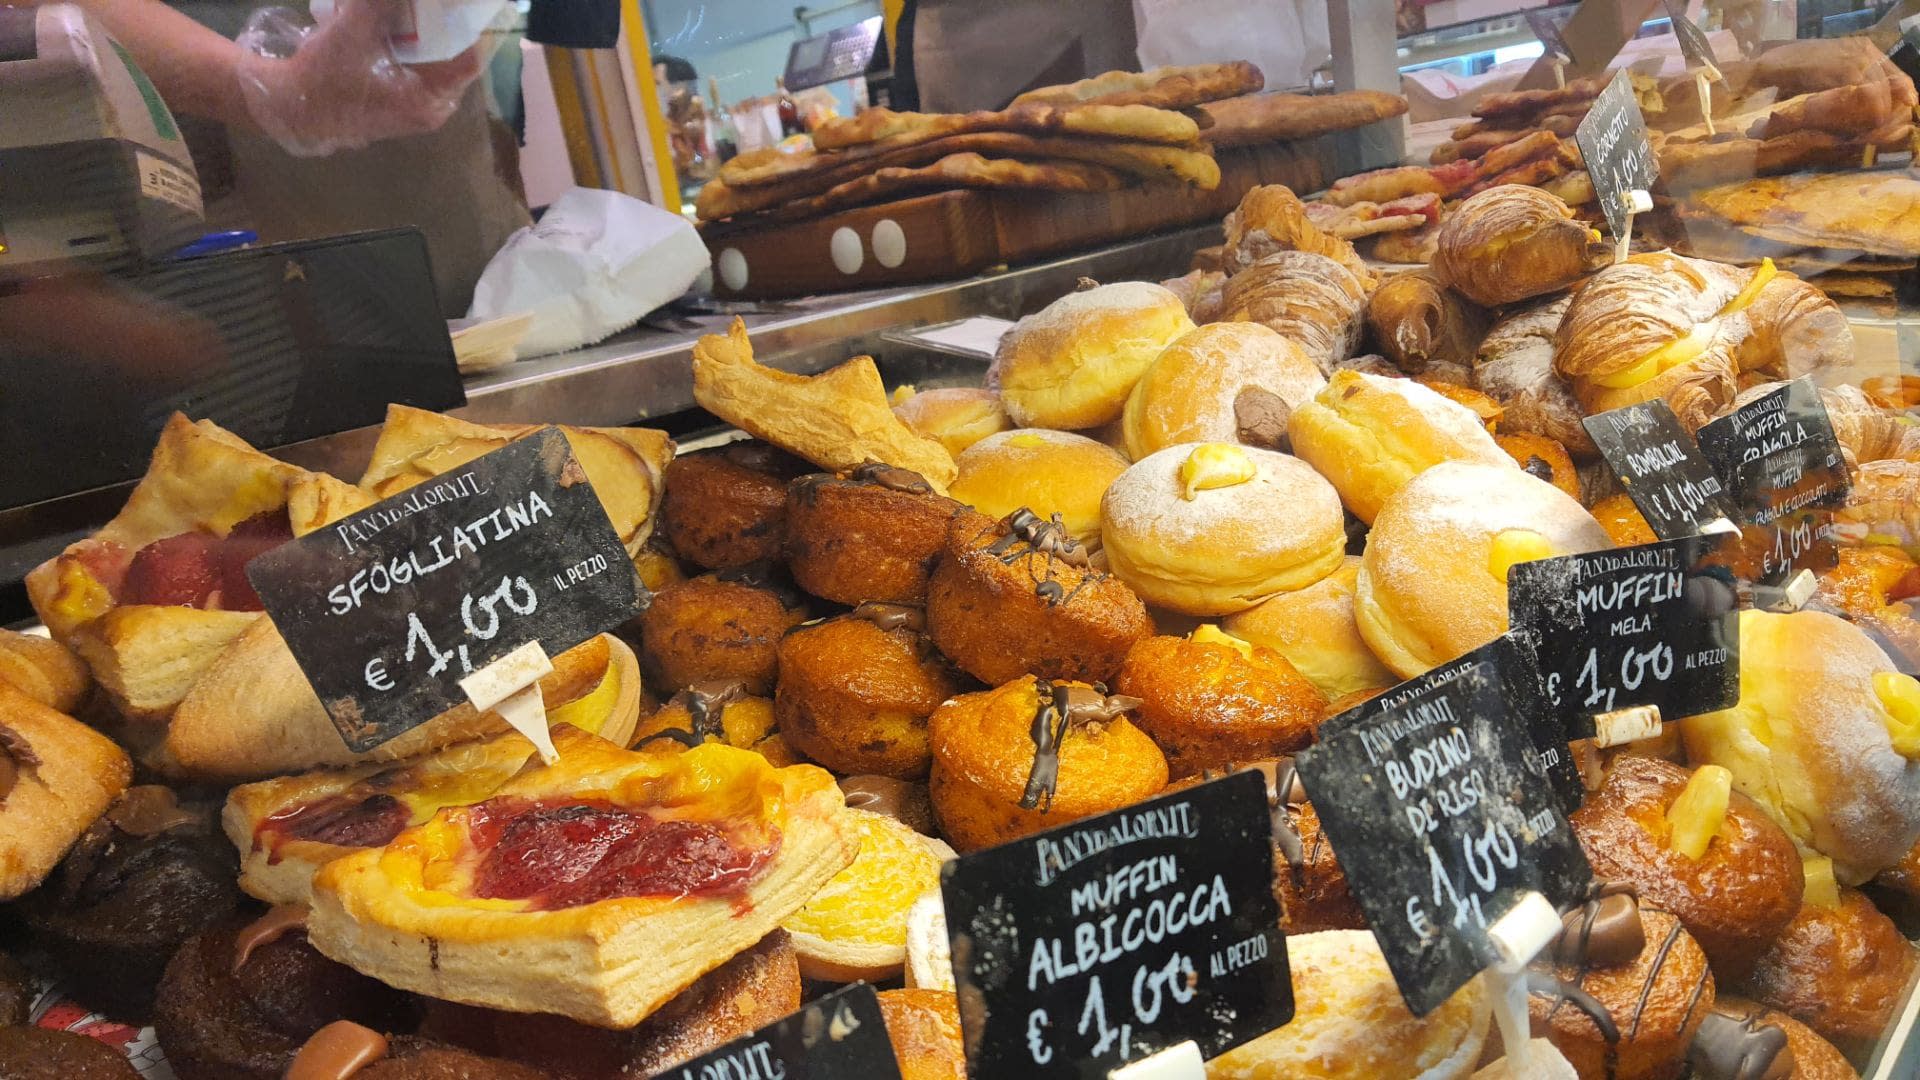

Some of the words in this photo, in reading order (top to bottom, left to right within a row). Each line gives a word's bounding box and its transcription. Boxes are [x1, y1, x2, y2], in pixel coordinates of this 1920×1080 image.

[1745, 410, 1787, 441] MUFFIN
[1626, 440, 1687, 477] BOMBOLONI
[1773, 464, 1802, 490] MUFFIN
[1652, 494, 1671, 521] €
[1663, 480, 1704, 527] 1,00
[326, 491, 553, 615] SFOGLIATINA
[1763, 551, 1772, 574] €
[1774, 520, 1811, 577] 1,00
[364, 657, 396, 692] €
[405, 575, 538, 678] 1,00
[553, 575, 569, 592] IL
[567, 553, 608, 585] PEZZO
[1576, 571, 1684, 613] MUFFIN
[1610, 614, 1651, 637] MELA
[1547, 672, 1561, 706] €
[1576, 641, 1674, 712] 1,00
[1685, 654, 1697, 670] AL
[1698, 648, 1727, 667] PEZZO
[1385, 727, 1472, 801] BUDINO
[1540, 748, 1559, 770] ZZO
[1406, 797, 1440, 839] DI
[1436, 769, 1486, 817] RISO
[1071, 855, 1178, 917] MUFFIN
[1406, 895, 1431, 938] €
[1428, 818, 1519, 930] 1,00
[1028, 874, 1232, 992] ALBICOCCA
[1026, 1008, 1053, 1065] €
[1078, 952, 1198, 1060] 1,00
[1210, 951, 1224, 979] AL
[1227, 934, 1269, 972] PEZZO
